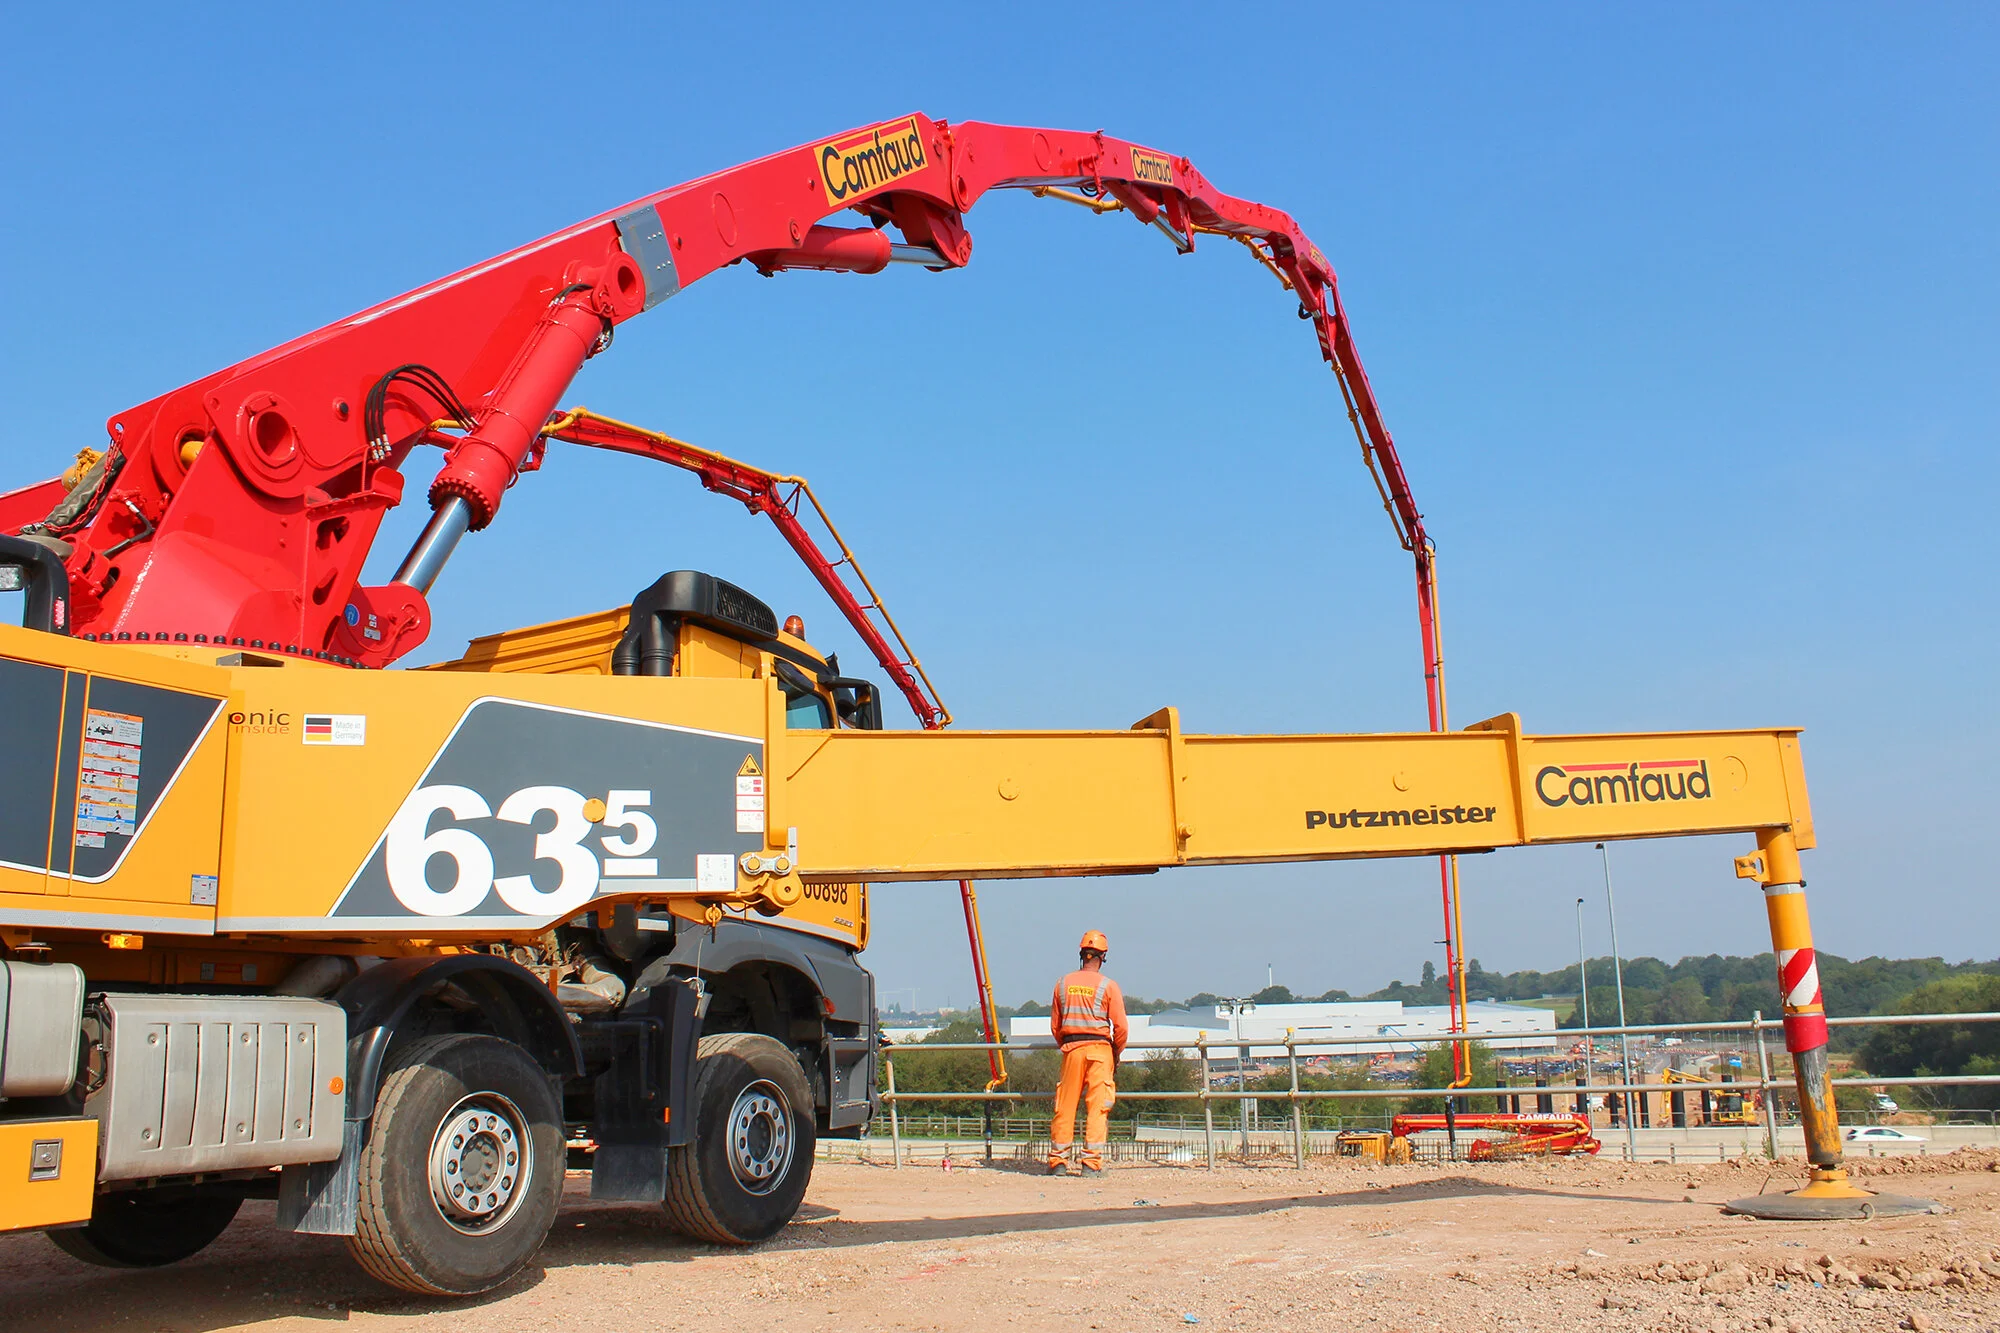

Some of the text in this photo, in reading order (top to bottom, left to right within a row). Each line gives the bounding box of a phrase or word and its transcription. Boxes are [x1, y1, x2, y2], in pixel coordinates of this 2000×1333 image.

[822, 119, 925, 199] Camfaud
[1132, 149, 1171, 183] Camfaud
[235, 724, 290, 734] inside
[335, 731, 363, 741] Germany
[336, 721, 361, 730] Made in
[1536, 760, 1711, 807] Camfaud
[1305, 805, 1496, 830] Putzmeister
